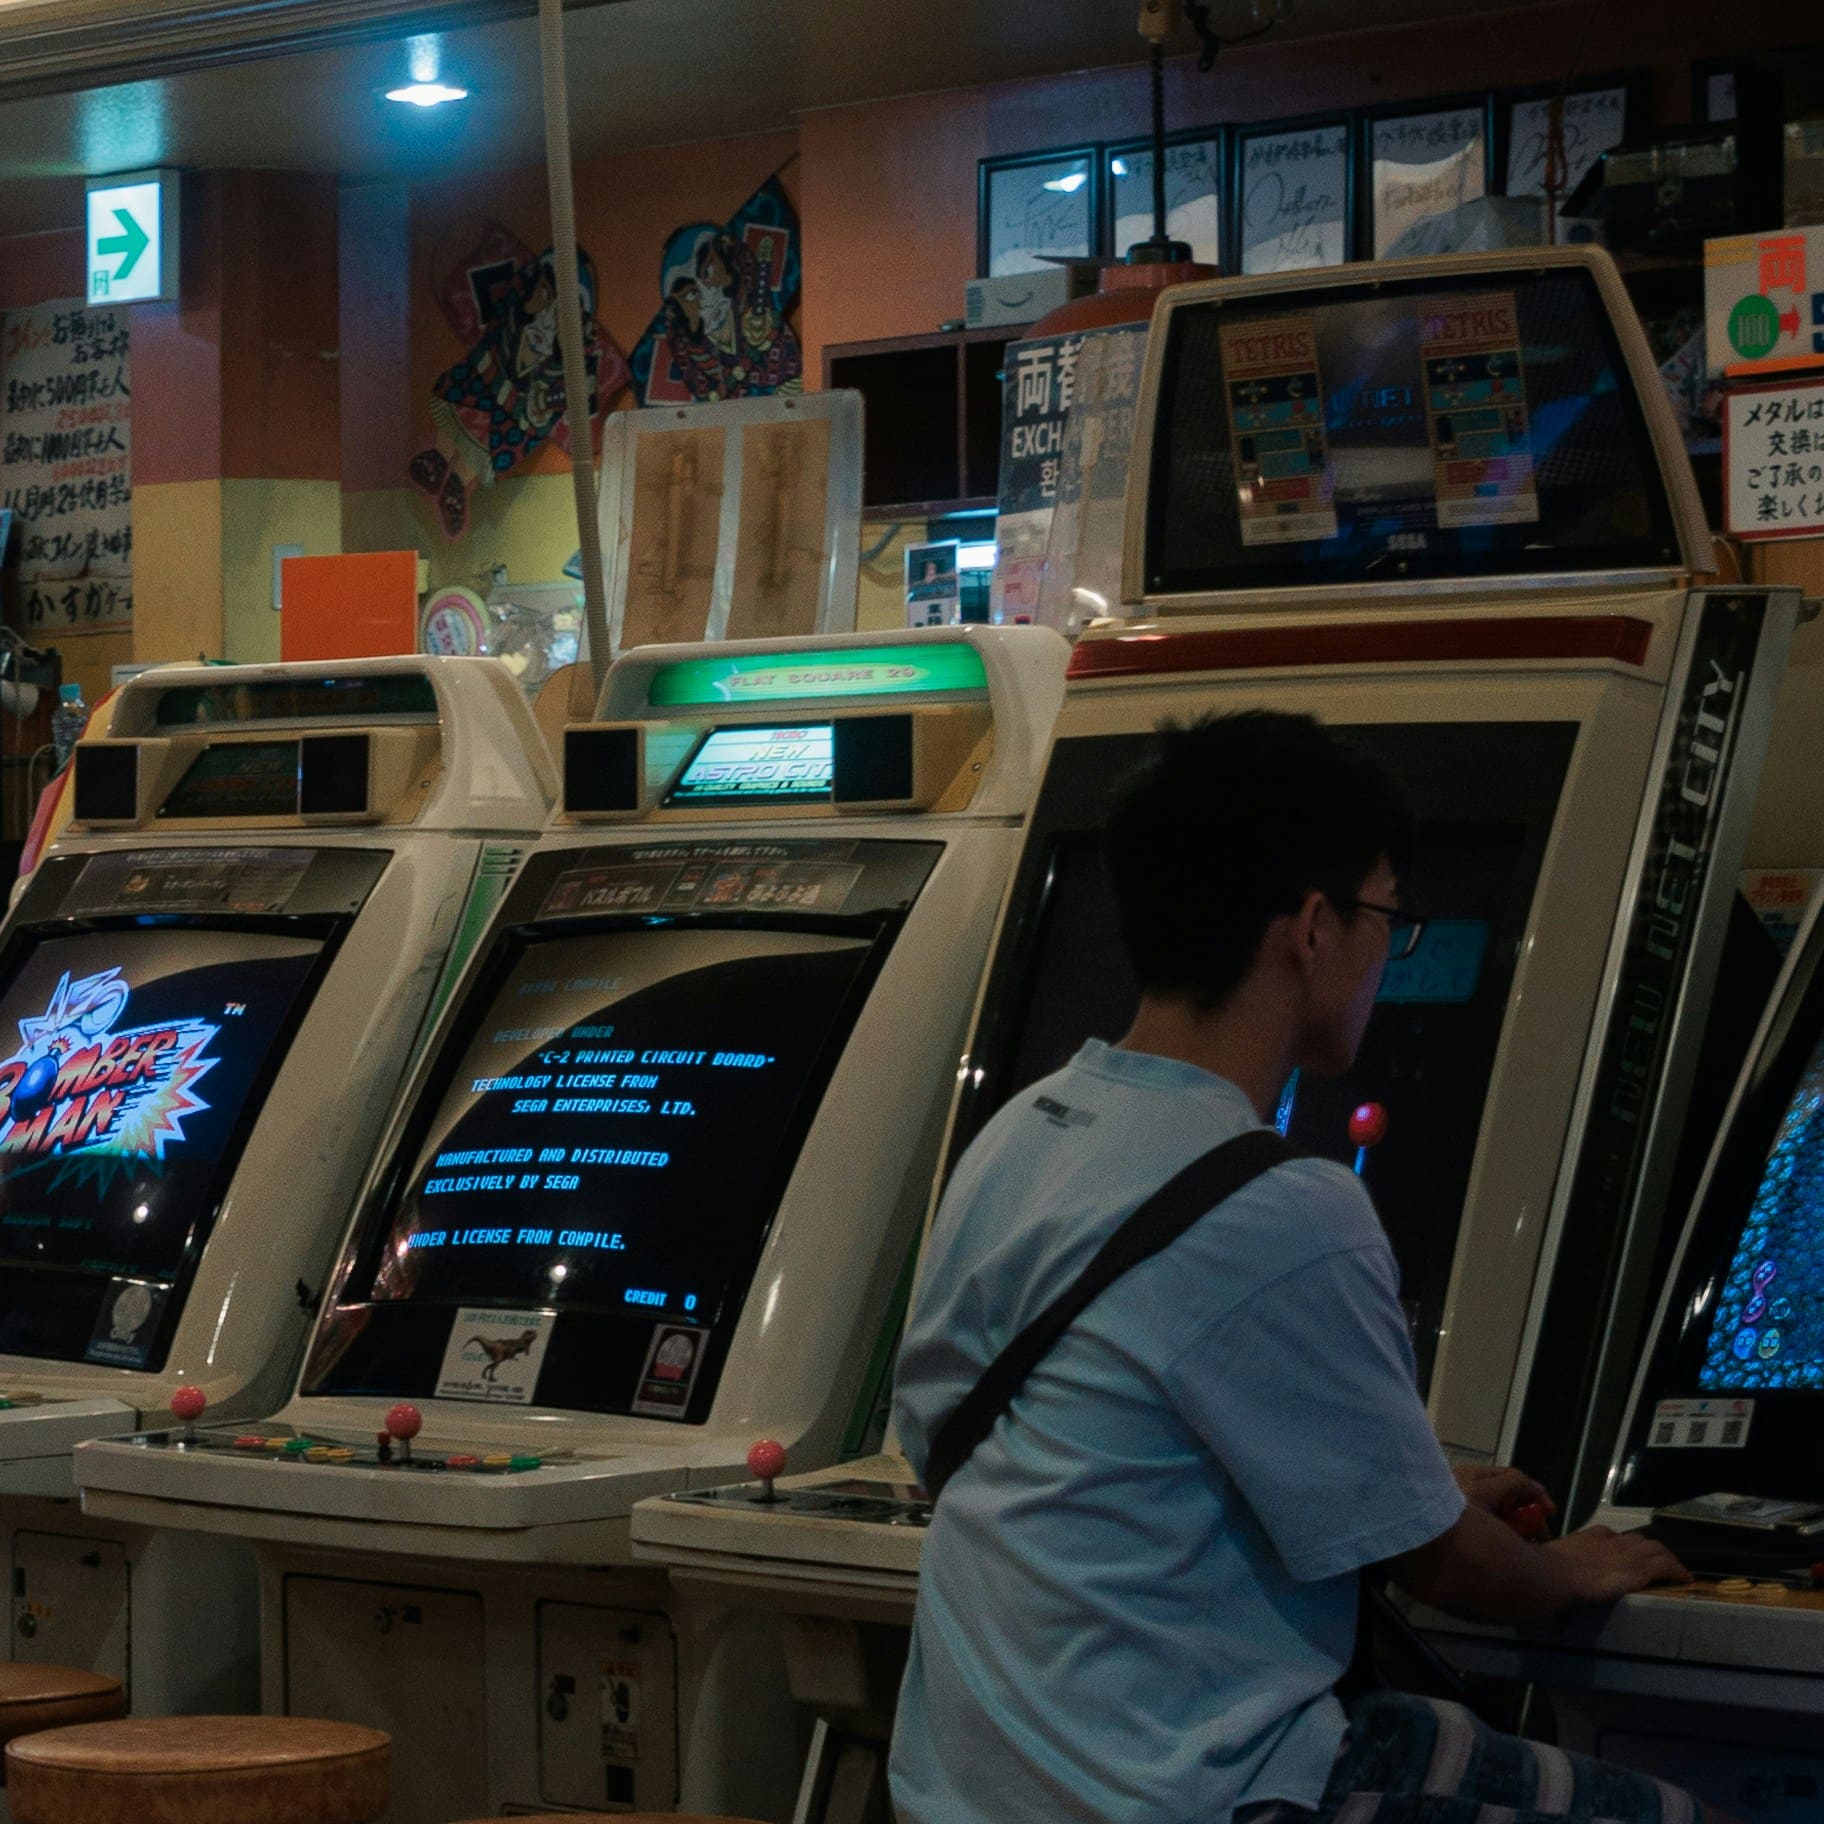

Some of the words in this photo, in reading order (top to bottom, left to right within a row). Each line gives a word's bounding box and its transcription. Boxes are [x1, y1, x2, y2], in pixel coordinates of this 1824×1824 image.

[1428, 309, 1512, 340] TETRIS
[1228, 331, 1309, 363] TETRIS
[729, 675, 777, 688] FLAT
[787, 669, 874, 684] SQUARE
[1680, 658, 1736, 808] CITY
[748, 744, 810, 761] NEW
[687, 763, 784, 783] ASTRO
[783, 761, 834, 779] CIT
[224, 1002, 247, 1016] TM
[571, 1025, 615, 1039] UNDER
[576, 1050, 635, 1064] PRINTED
[641, 1050, 707, 1065] CIRCUIT
[471, 1075, 551, 1092] TECHNOLOGY
[556, 1075, 616, 1088] LICENSE
[621, 1075, 659, 1089] FROM
[512, 1099, 547, 1113] SEGA
[552, 1099, 651, 1114] ENTERPRISES,
[661, 1101, 697, 1116] LTD.
[435, 1148, 533, 1168] MANUFACTURED
[538, 1148, 564, 1163] AND
[571, 1148, 670, 1167] DISTRIBUTED
[425, 1175, 515, 1195] EXCLUSIVELY
[520, 1175, 539, 1189] BY
[544, 1175, 580, 1190] SEGA
[407, 1231, 446, 1248] UNDER
[452, 1229, 512, 1245] LICENSE
[517, 1229, 552, 1245] FROM
[559, 1230, 626, 1250] COMPILE.
[625, 1289, 668, 1307] CREDIT
[684, 1294, 697, 1310] 0
